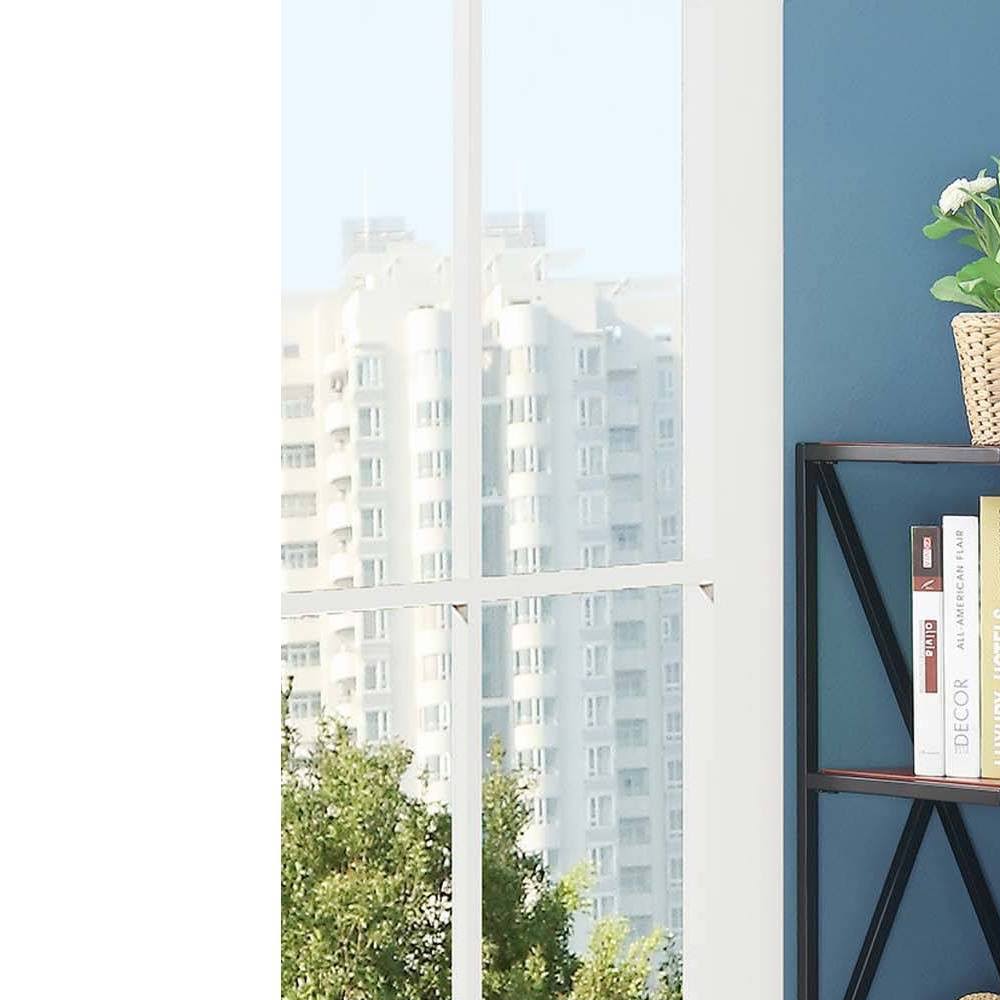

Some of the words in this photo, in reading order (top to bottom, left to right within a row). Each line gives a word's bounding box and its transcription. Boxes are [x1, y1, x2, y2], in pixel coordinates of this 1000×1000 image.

[956, 530, 964, 560] FLAIR
[924, 621, 936, 657] olivia
[953, 679, 969, 747] DECOR
